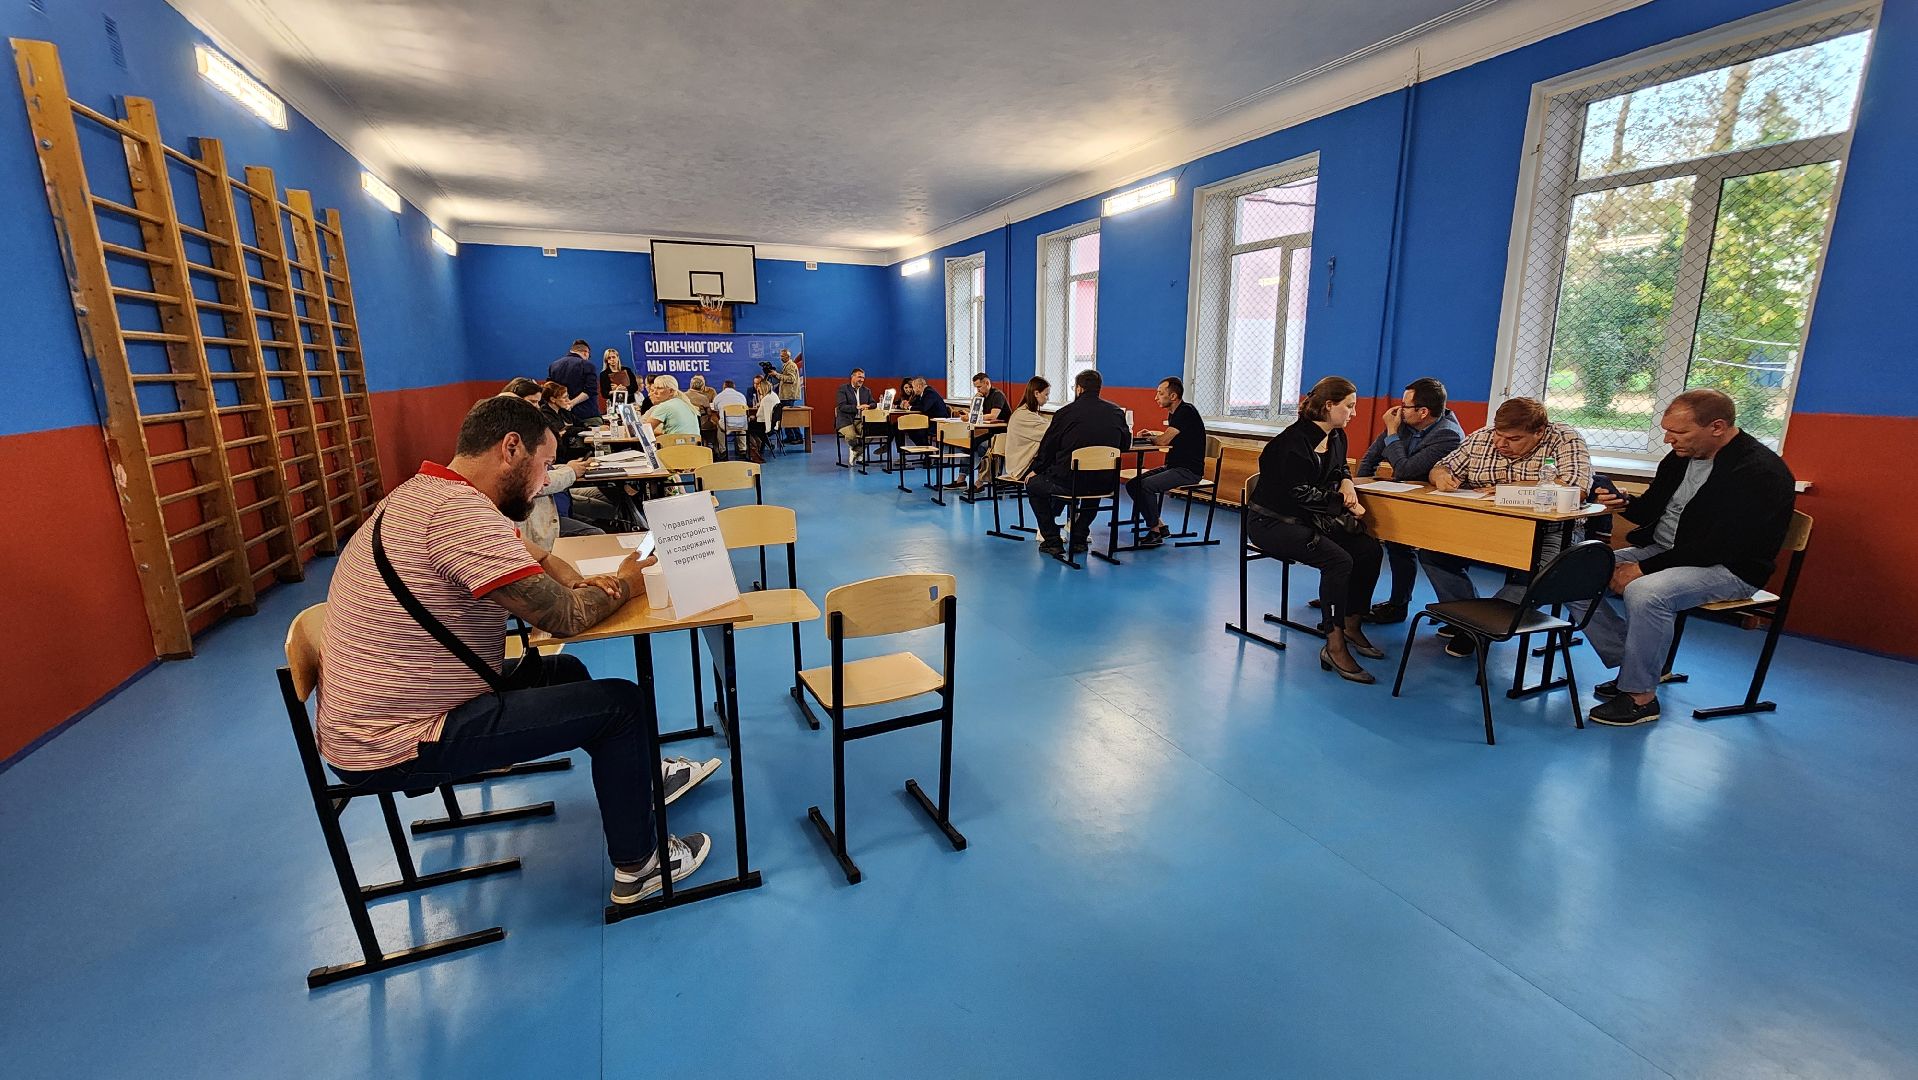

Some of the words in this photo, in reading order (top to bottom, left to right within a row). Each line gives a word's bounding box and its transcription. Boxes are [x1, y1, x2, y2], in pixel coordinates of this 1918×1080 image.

[645, 341, 733, 353] СОЛНЕЧНОГОРСК
[647, 360, 667, 372] МЫ
[669, 360, 710, 372] ВМЕСТЕ
[662, 515, 706, 531] Управление
[657, 525, 718, 545] благоустройства
[673, 537, 716, 553] содержания
[673, 550, 715, 566] территории
